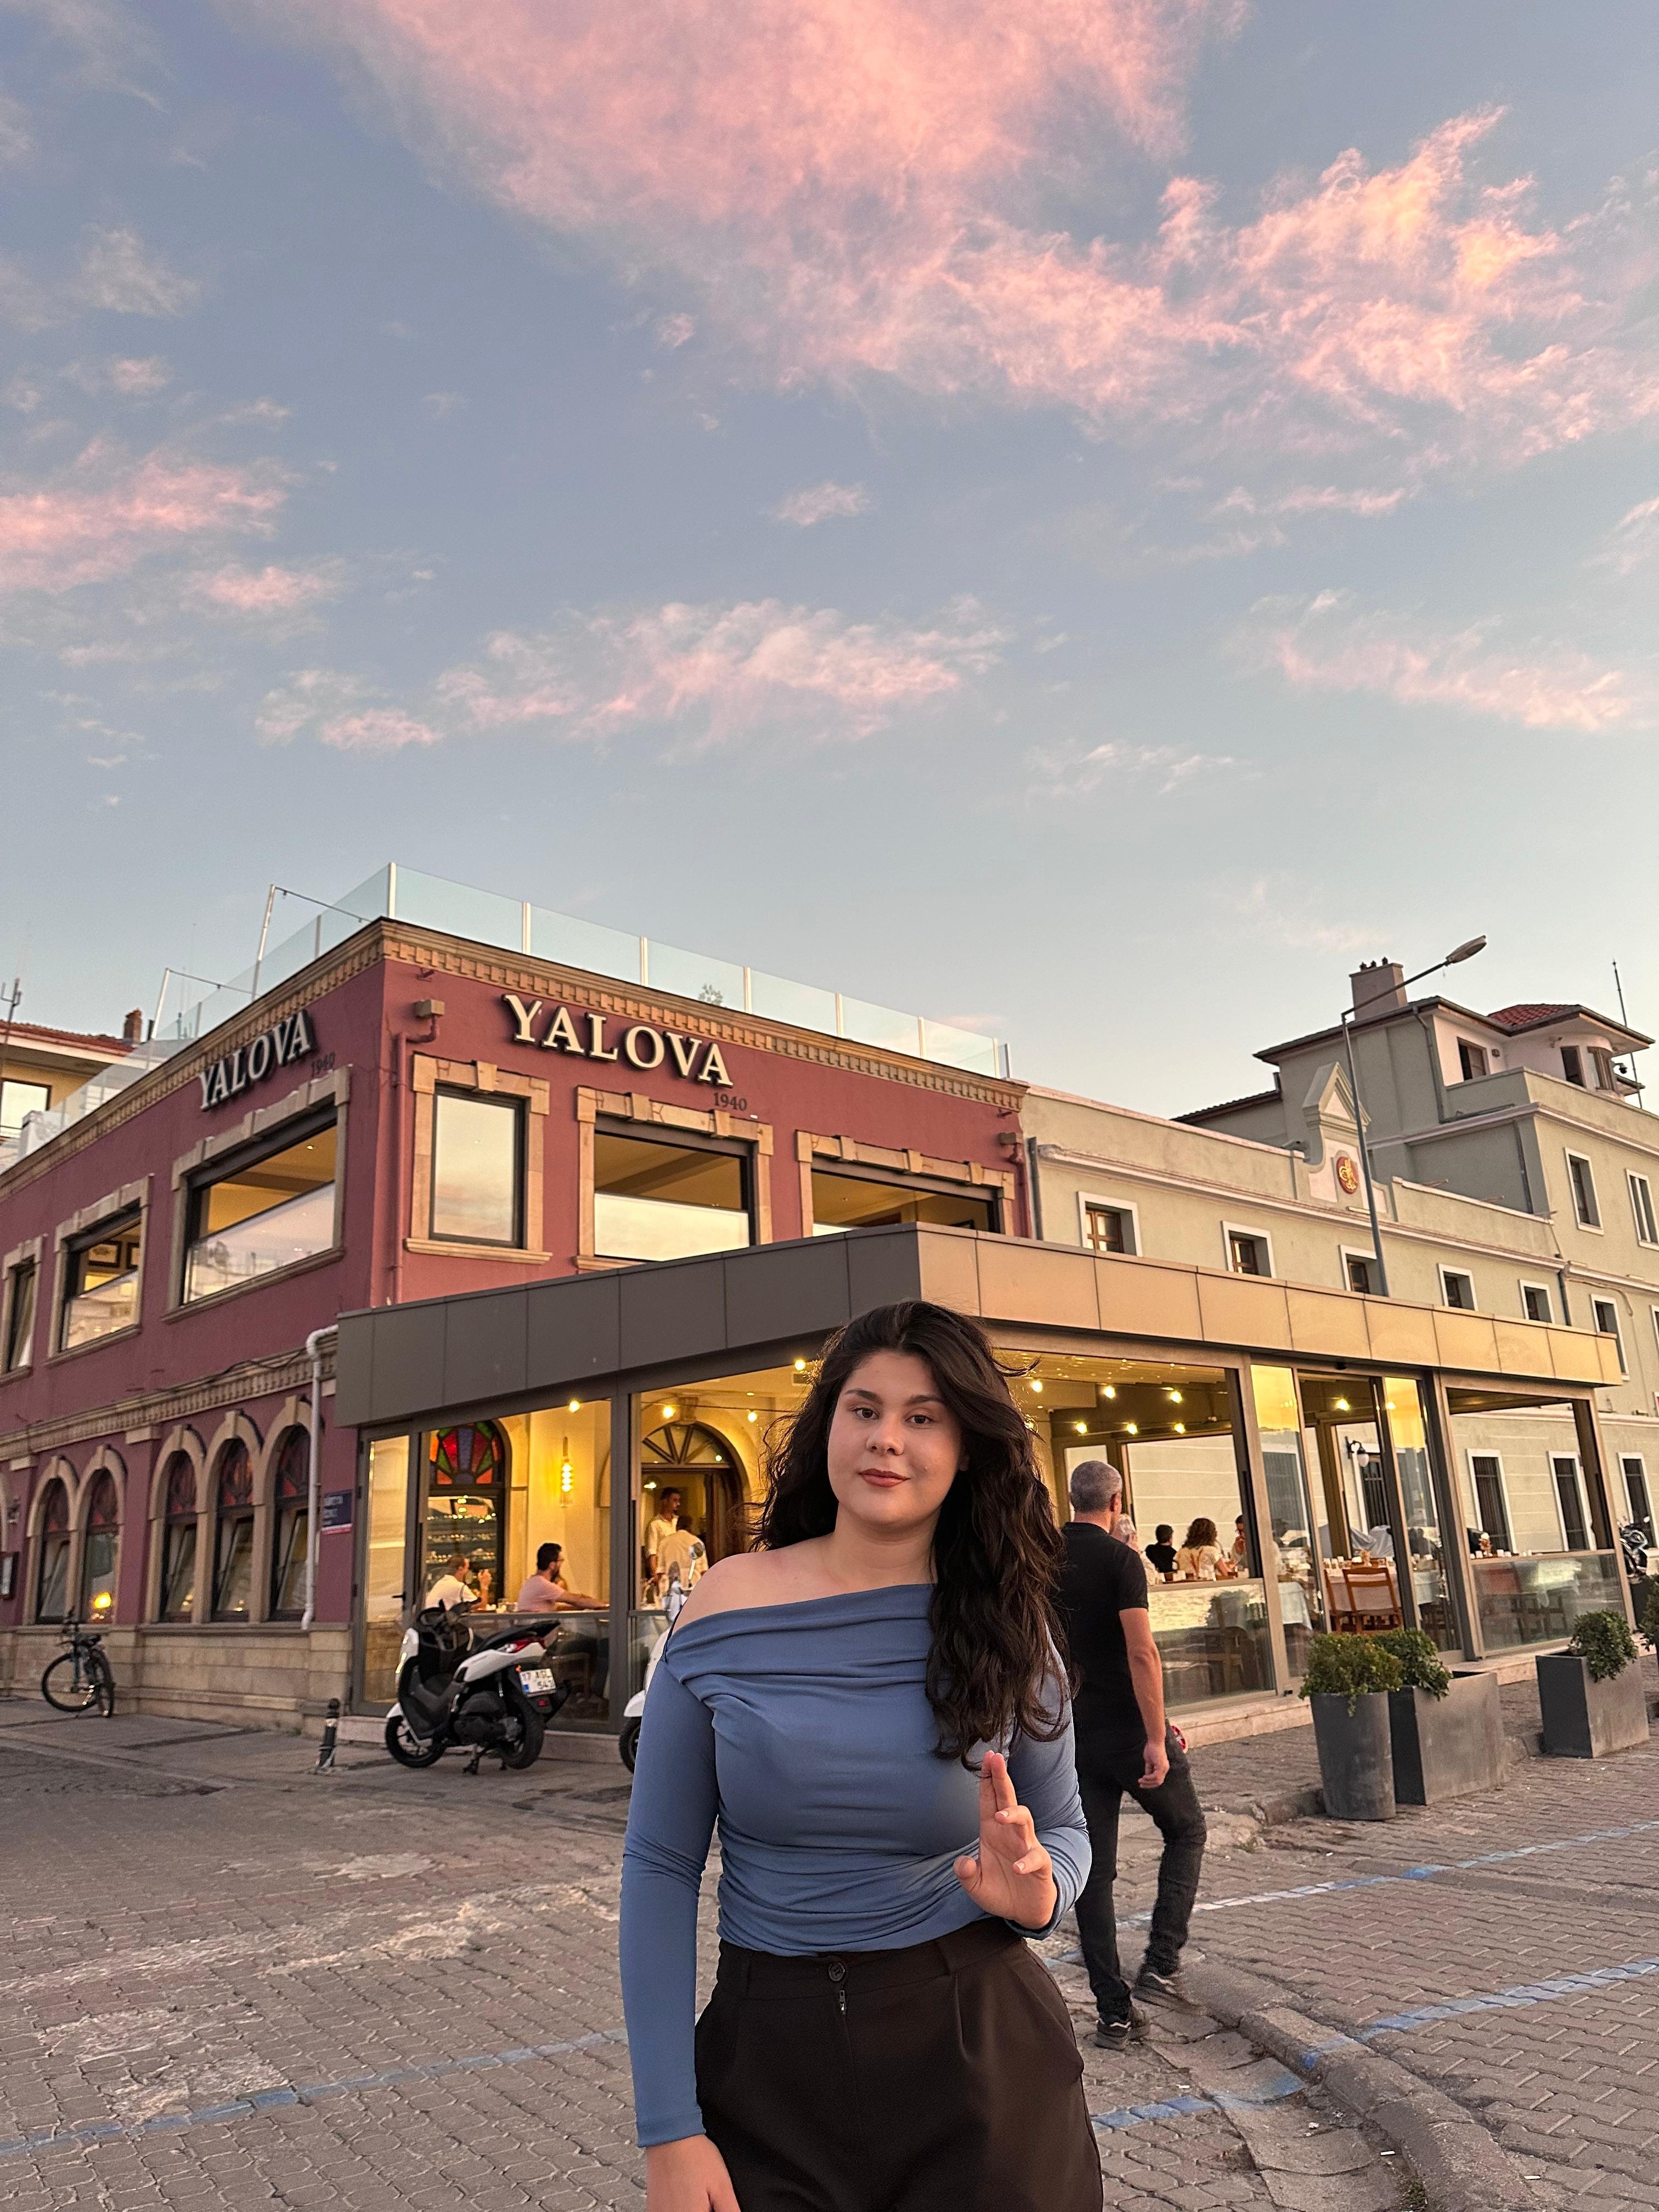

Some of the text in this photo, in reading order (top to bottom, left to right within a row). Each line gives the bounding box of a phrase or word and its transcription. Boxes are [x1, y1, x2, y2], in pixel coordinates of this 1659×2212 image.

[199, 1009, 314, 1111] YALOVA
[502, 994, 733, 1087] YALOVA
[714, 1092, 747, 1111] 1940
